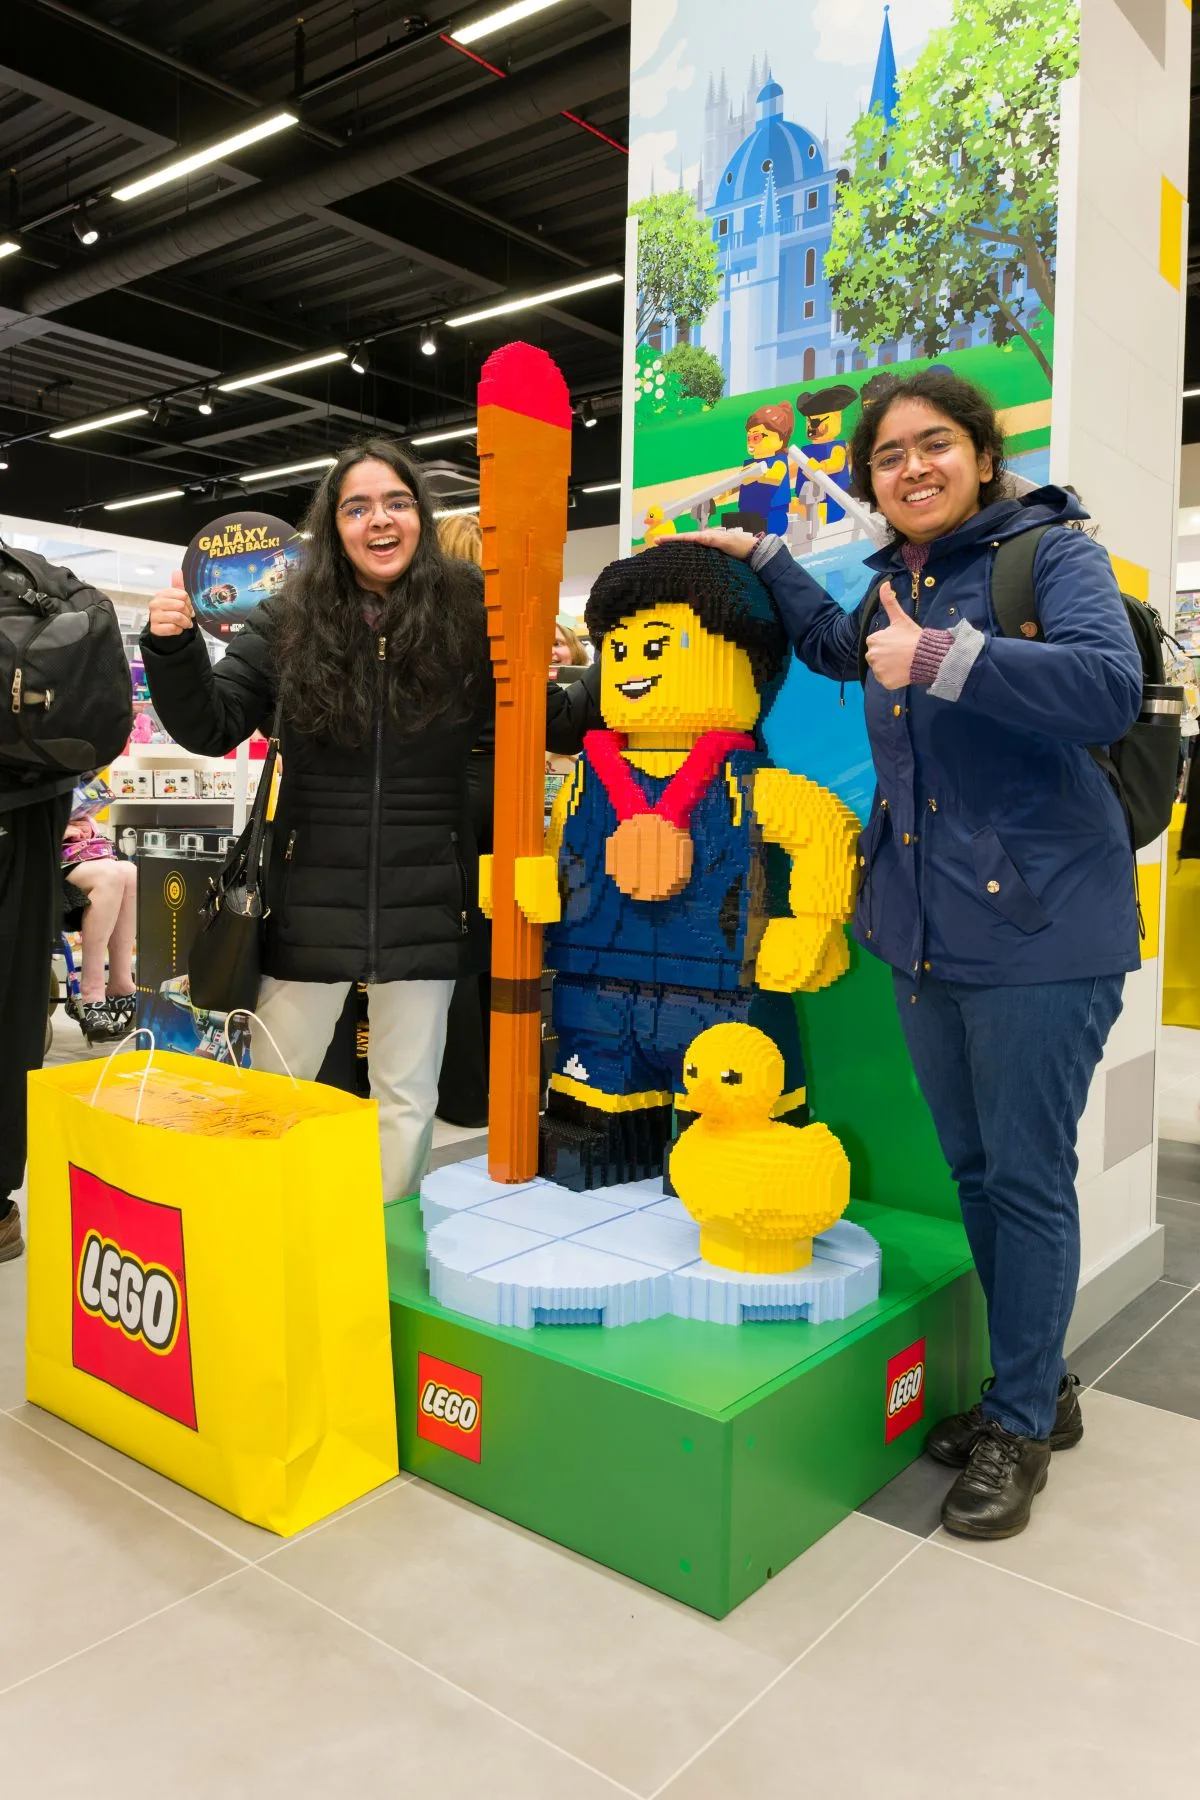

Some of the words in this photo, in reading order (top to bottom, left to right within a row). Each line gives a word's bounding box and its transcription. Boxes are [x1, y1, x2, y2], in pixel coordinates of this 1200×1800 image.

[198, 526, 268, 551] GALAXY
[225, 524, 242, 533] THE
[209, 545, 244, 558] PLAYS
[245, 537, 280, 552] BACK!
[79, 1233, 179, 1351] LEGO
[422, 1382, 478, 1430] LEGO
[888, 1364, 923, 1416] LEGO
